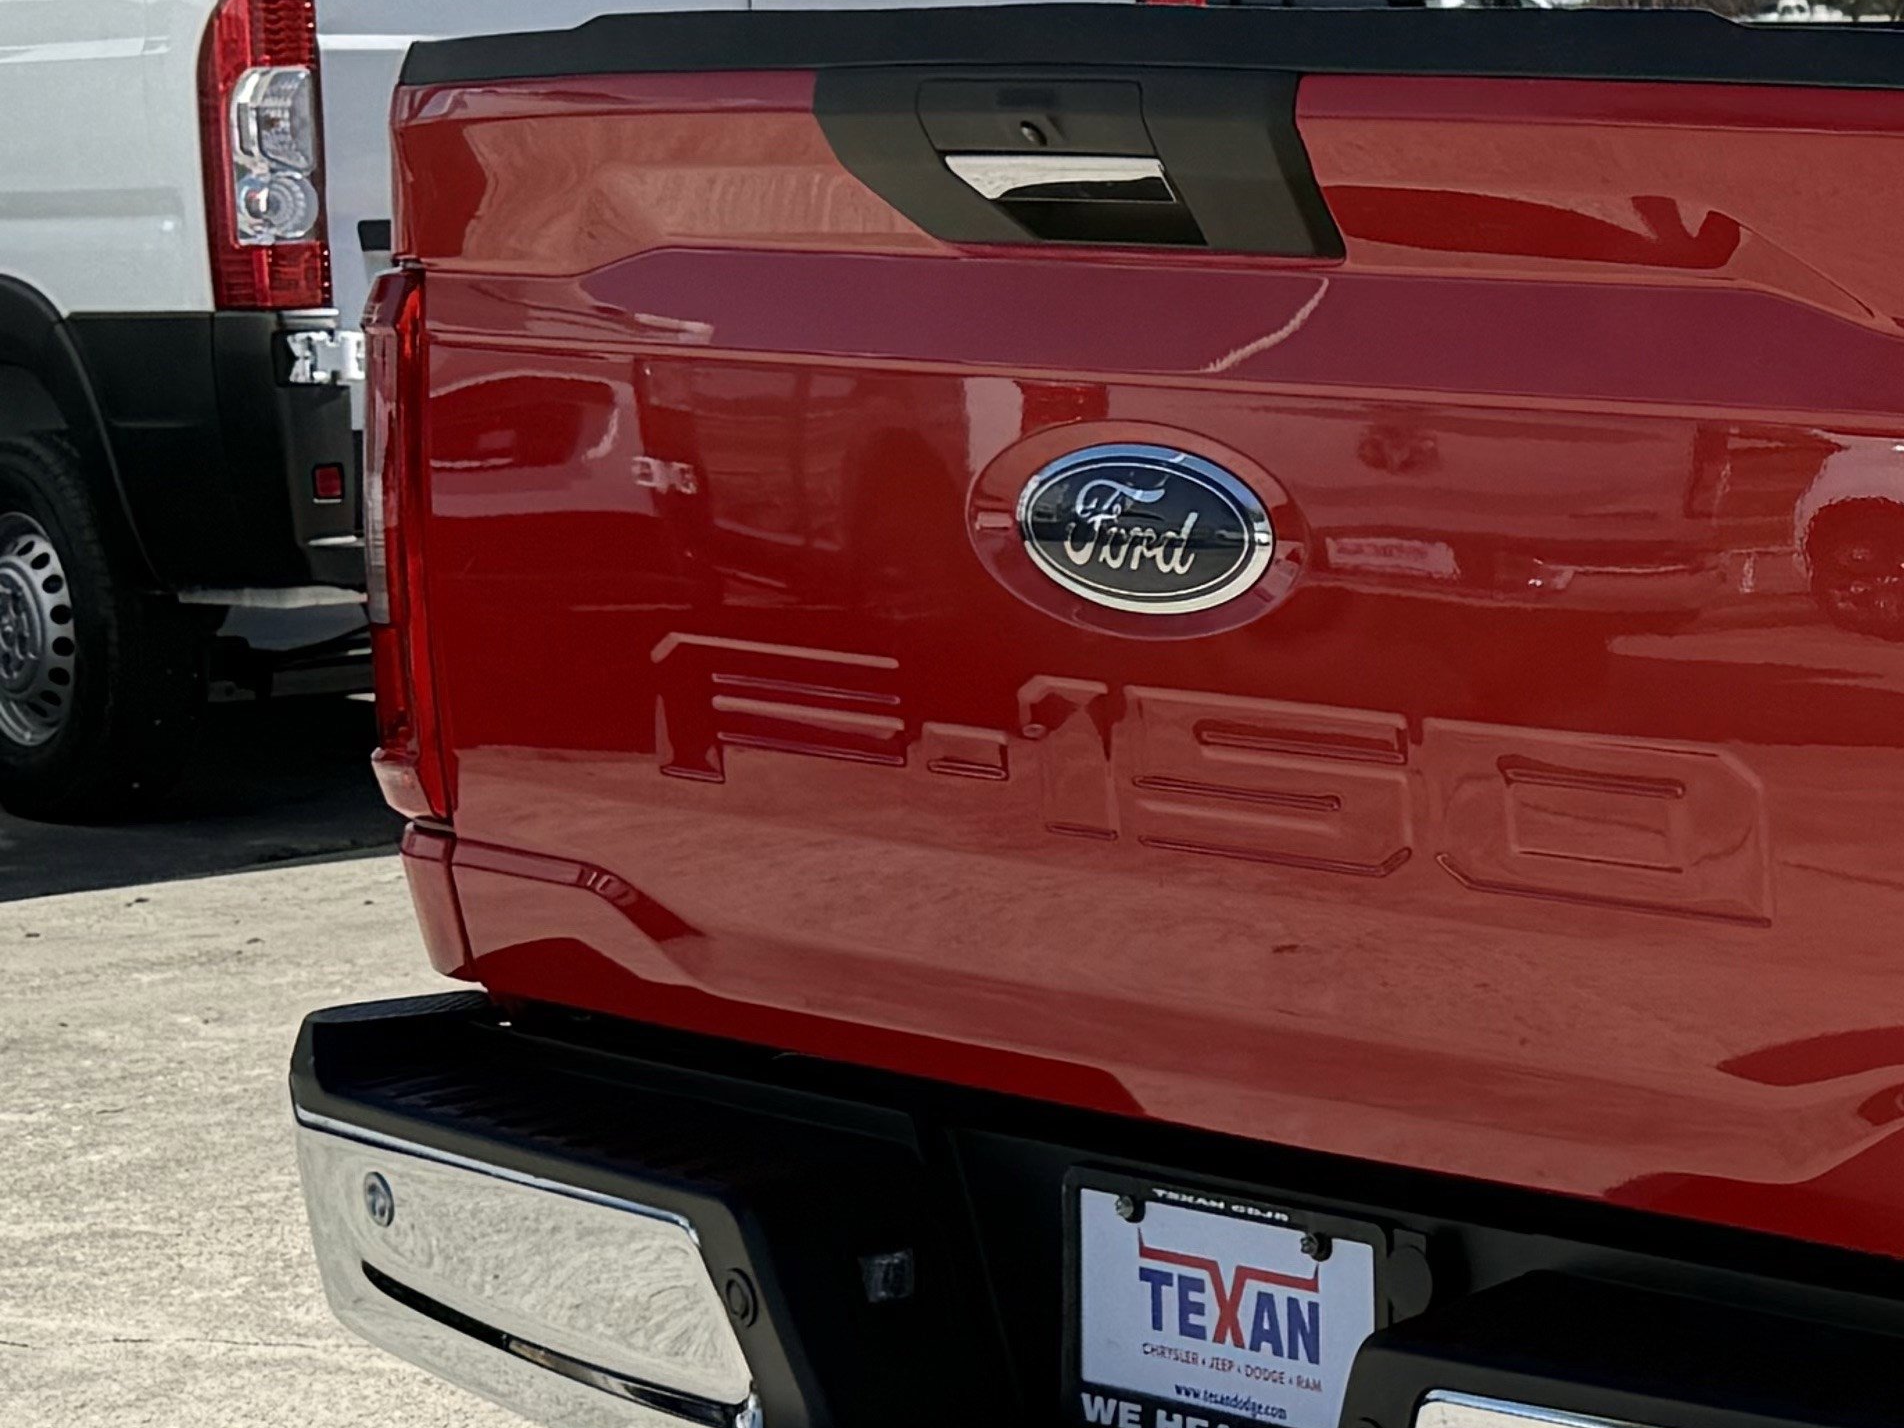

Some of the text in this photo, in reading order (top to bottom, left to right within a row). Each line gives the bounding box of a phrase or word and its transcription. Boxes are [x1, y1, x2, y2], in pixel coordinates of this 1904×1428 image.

[1064, 478, 1199, 574] Ford
[1138, 1254, 1321, 1365] TEXAN
[1142, 1342, 1199, 1366] CHRYSLER
[1210, 1356, 1235, 1374] JEEP
[1244, 1364, 1286, 1386] DODGE
